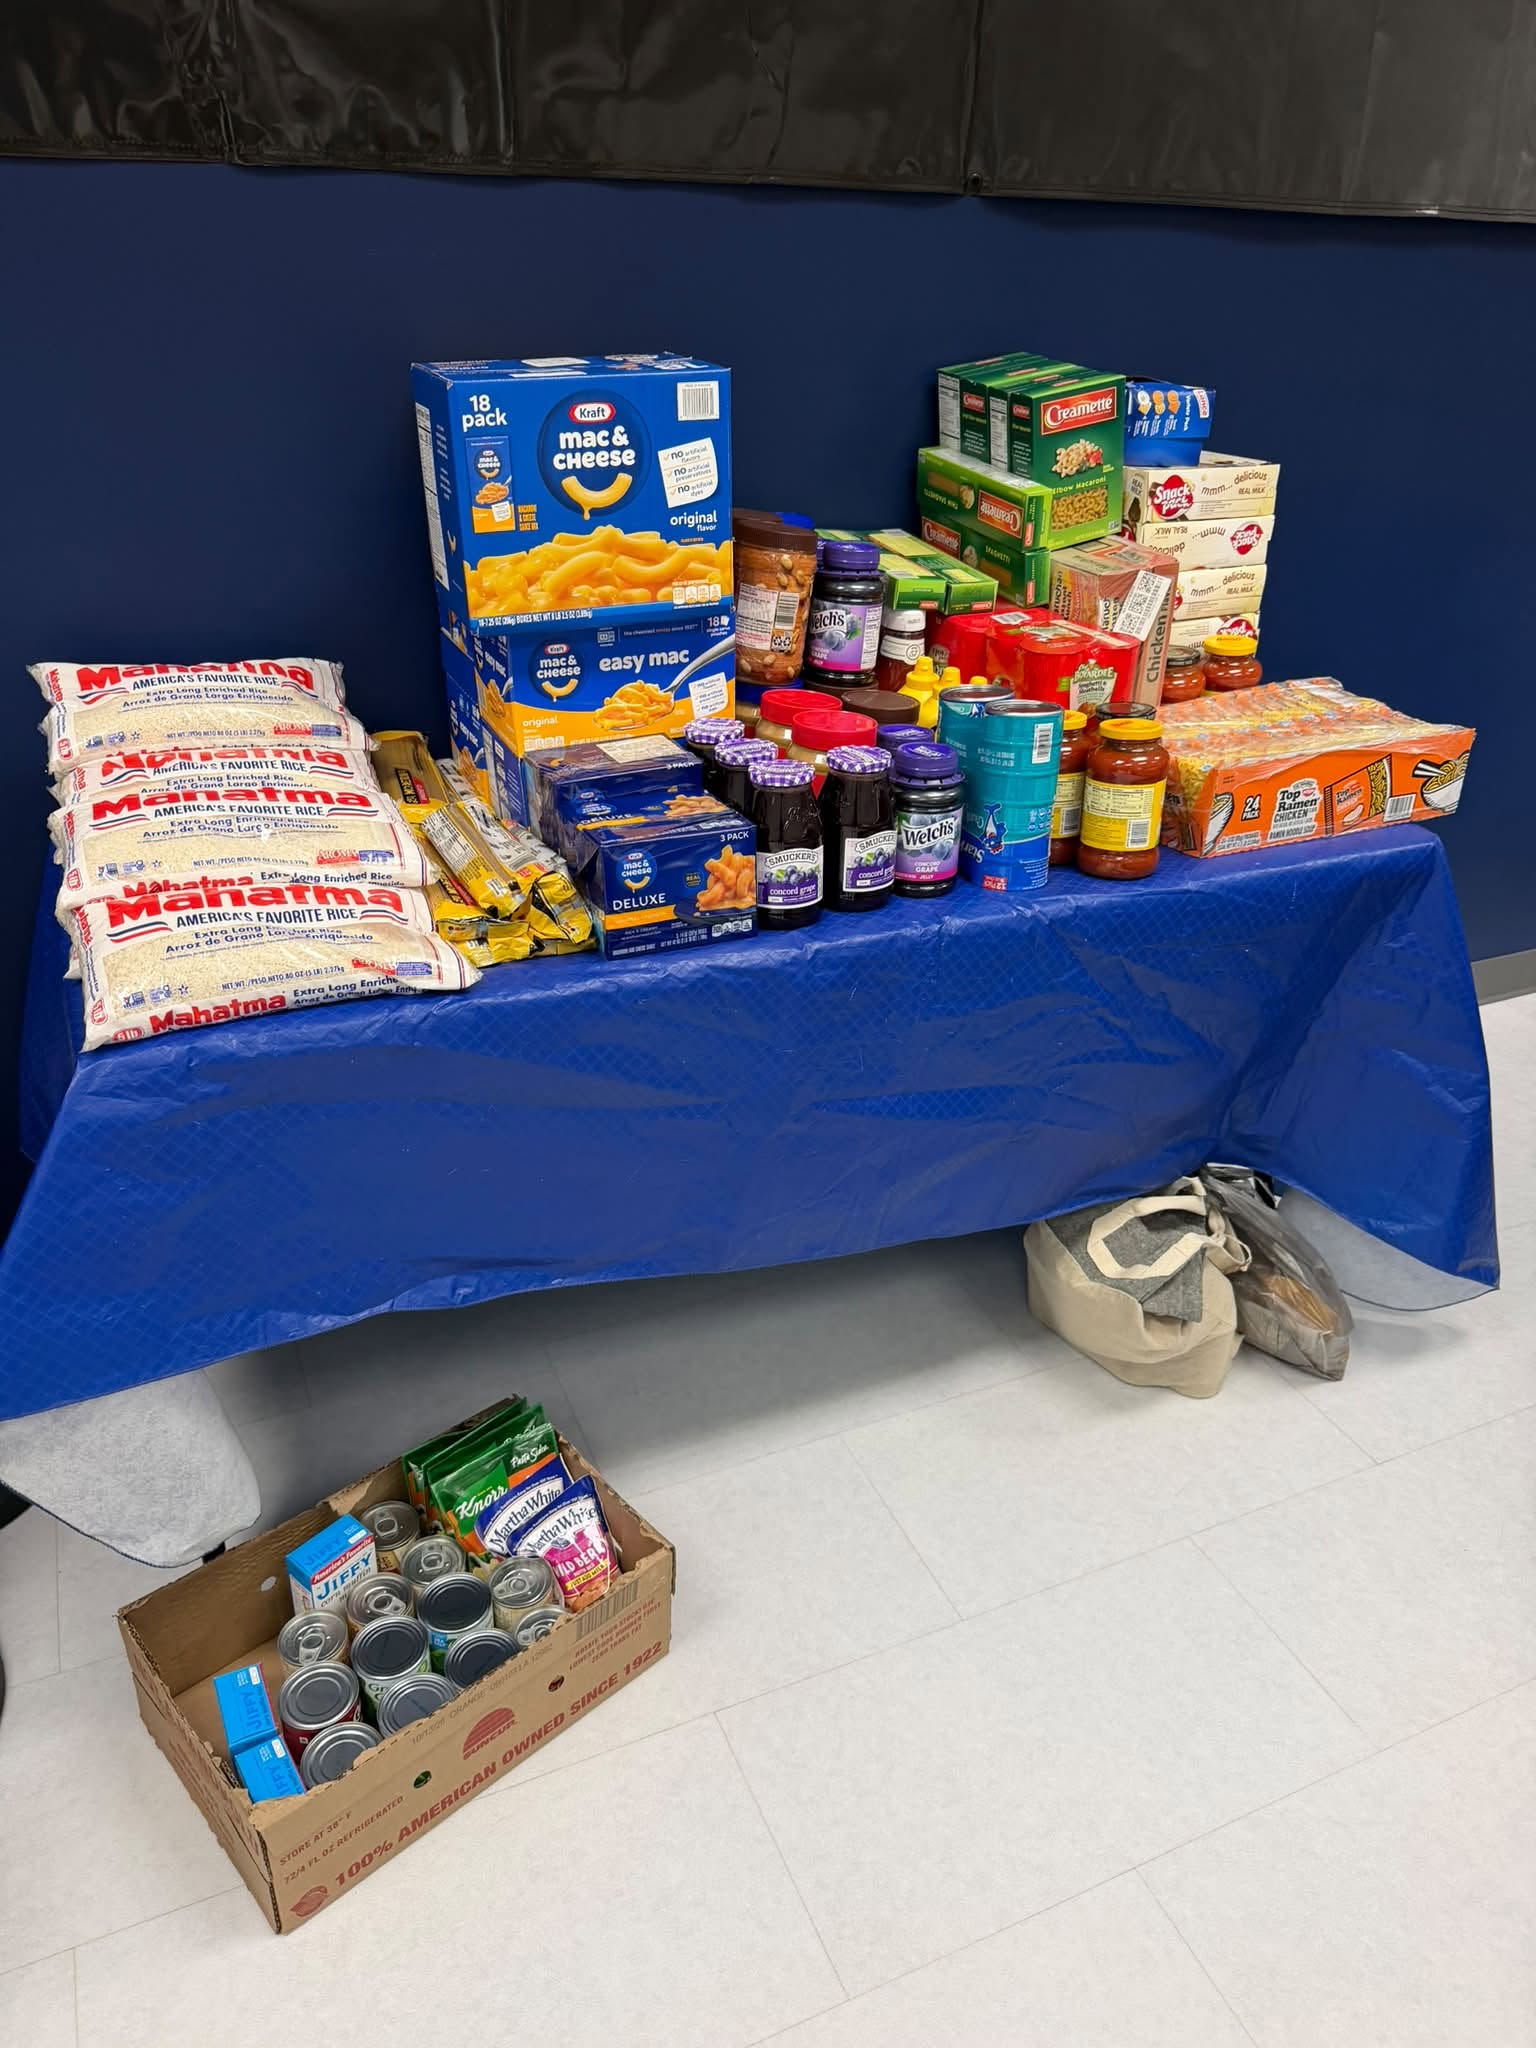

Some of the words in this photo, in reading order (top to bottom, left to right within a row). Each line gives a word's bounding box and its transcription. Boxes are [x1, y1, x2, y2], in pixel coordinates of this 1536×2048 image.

[469, 394, 491, 412] 18
[579, 404, 606, 419] Kraft
[1046, 394, 1113, 429] Creamette
[462, 408, 508, 432] pack
[559, 428, 610, 449] mac
[612, 425, 630, 447] &
[671, 450, 684, 460] no
[674, 467, 687, 477] no
[1234, 469, 1268, 485] delicious
[677, 484, 690, 494] no
[1075, 476, 1107, 490] Macaroni
[1154, 482, 1191, 504] Snack
[670, 509, 718, 527] original
[980, 501, 1021, 532] Creamette
[697, 524, 717, 532] flavor
[1222, 570, 1256, 586] delicious
[532, 613, 542, 622] NET
[543, 612, 551, 621] WT
[707, 616, 720, 627] 18
[811, 611, 845, 630] elch's
[1147, 614, 1167, 683] Chicken
[540, 657, 567, 668] mac
[567, 655, 578, 665] &
[599, 654, 645, 674] easy
[648, 649, 690, 667] mac
[132, 674, 194, 691] AMERICA'S
[197, 674, 253, 684] FAVORITE
[254, 676, 280, 686] RICE
[522, 717, 558, 728] original
[221, 759, 278, 771] FAVORITE
[281, 759, 308, 772] RICE
[1246, 795, 1261, 811] 24
[1279, 789, 1301, 802] Top
[154, 803, 226, 819] AMERICA'S
[229, 804, 293, 816] FAVORITE
[295, 805, 325, 816] RICE
[1277, 798, 1319, 813] Ramen
[1242, 808, 1261, 821] PACK
[1274, 808, 1309, 823] CHICKEN
[720, 834, 726, 843] 3
[727, 831, 750, 842] PACK
[903, 819, 955, 847] Welch's
[623, 861, 642, 870] mac
[915, 865, 940, 873] GRAPE
[324, 872, 368, 883] Enriched
[858, 869, 884, 880] concord
[769, 886, 799, 896] concord
[106, 884, 404, 929] Mahatma
[612, 893, 667, 911] DELUXE
[176, 911, 253, 928] AMERICA'S
[256, 908, 324, 924] FAVORITE
[327, 908, 359, 920] RICE
[165, 941, 201, 953] Arroz
[205, 937, 223, 946] de
[225, 931, 265, 943] Grano
[149, 994, 287, 1034] Mahatma
[293, 986, 325, 998] Extra
[328, 982, 357, 993] Long
[360, 974, 400, 988] Enriche
[455, 1485, 509, 1520] Knorr
[490, 1505, 530, 1552] Martha
[526, 1488, 563, 1516] White
[317, 1552, 372, 1601] JIFFY
[335, 1839, 394, 1886] 100%
[398, 1761, 497, 1844] AMERICAN
[502, 1712, 565, 1766] OWNED
[569, 1673, 619, 1716] SINCE
[623, 1641, 663, 1676] 1922
[336, 1795, 405, 1847] REFRIGERATED
[279, 1840, 312, 1866] STORE
[313, 1830, 325, 1843] AT
